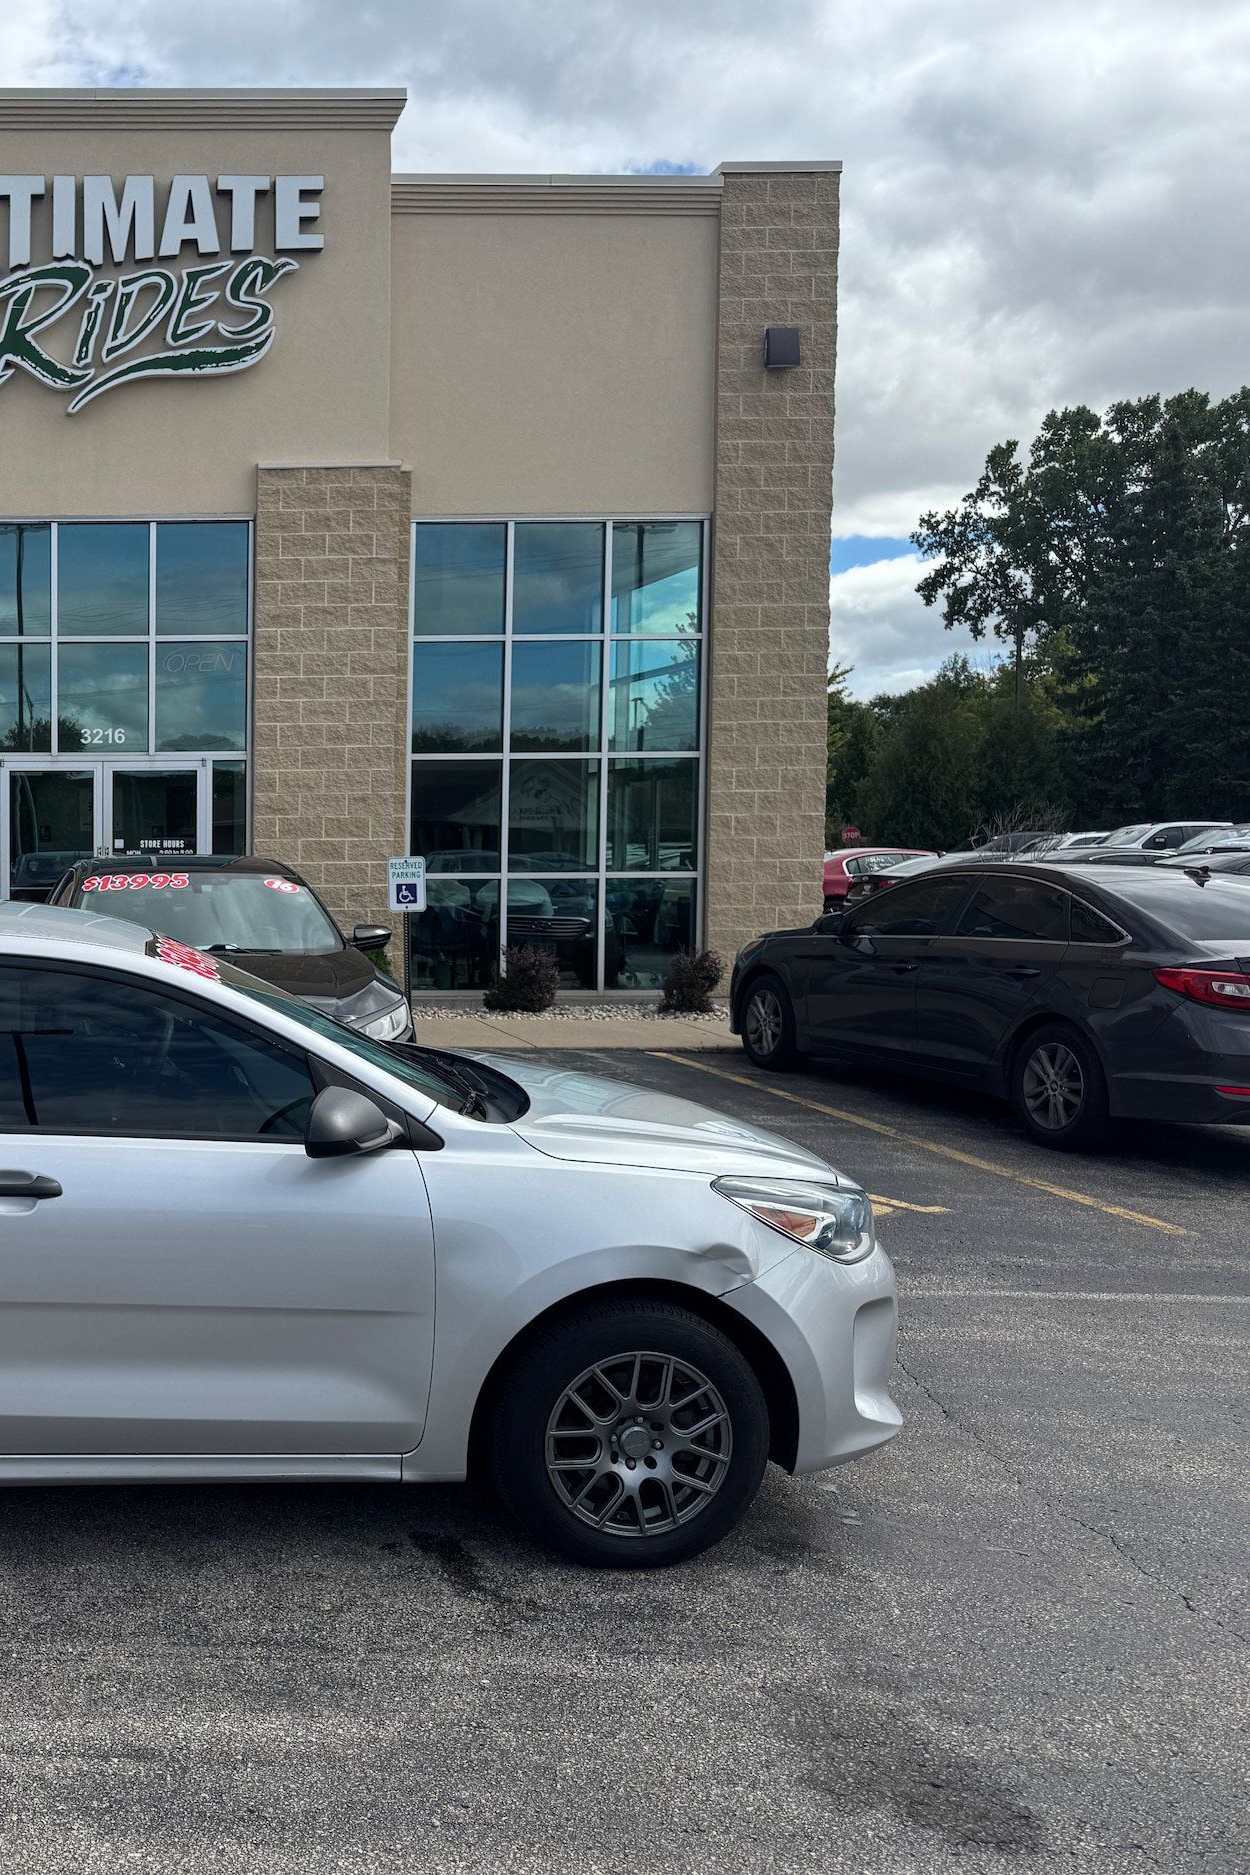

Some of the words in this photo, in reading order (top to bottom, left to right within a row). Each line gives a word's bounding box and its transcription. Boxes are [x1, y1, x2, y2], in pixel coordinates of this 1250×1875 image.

[166, 653, 235, 672] OPEN
[80, 728, 125, 744] 3216
[843, 832, 859, 840] STOP
[140, 840, 161, 848] STORE
[163, 840, 185, 848] HOURS
[390, 861, 422, 870] RESERVED
[392, 871, 421, 879] PARKING
[82, 873, 189, 891] $13995
